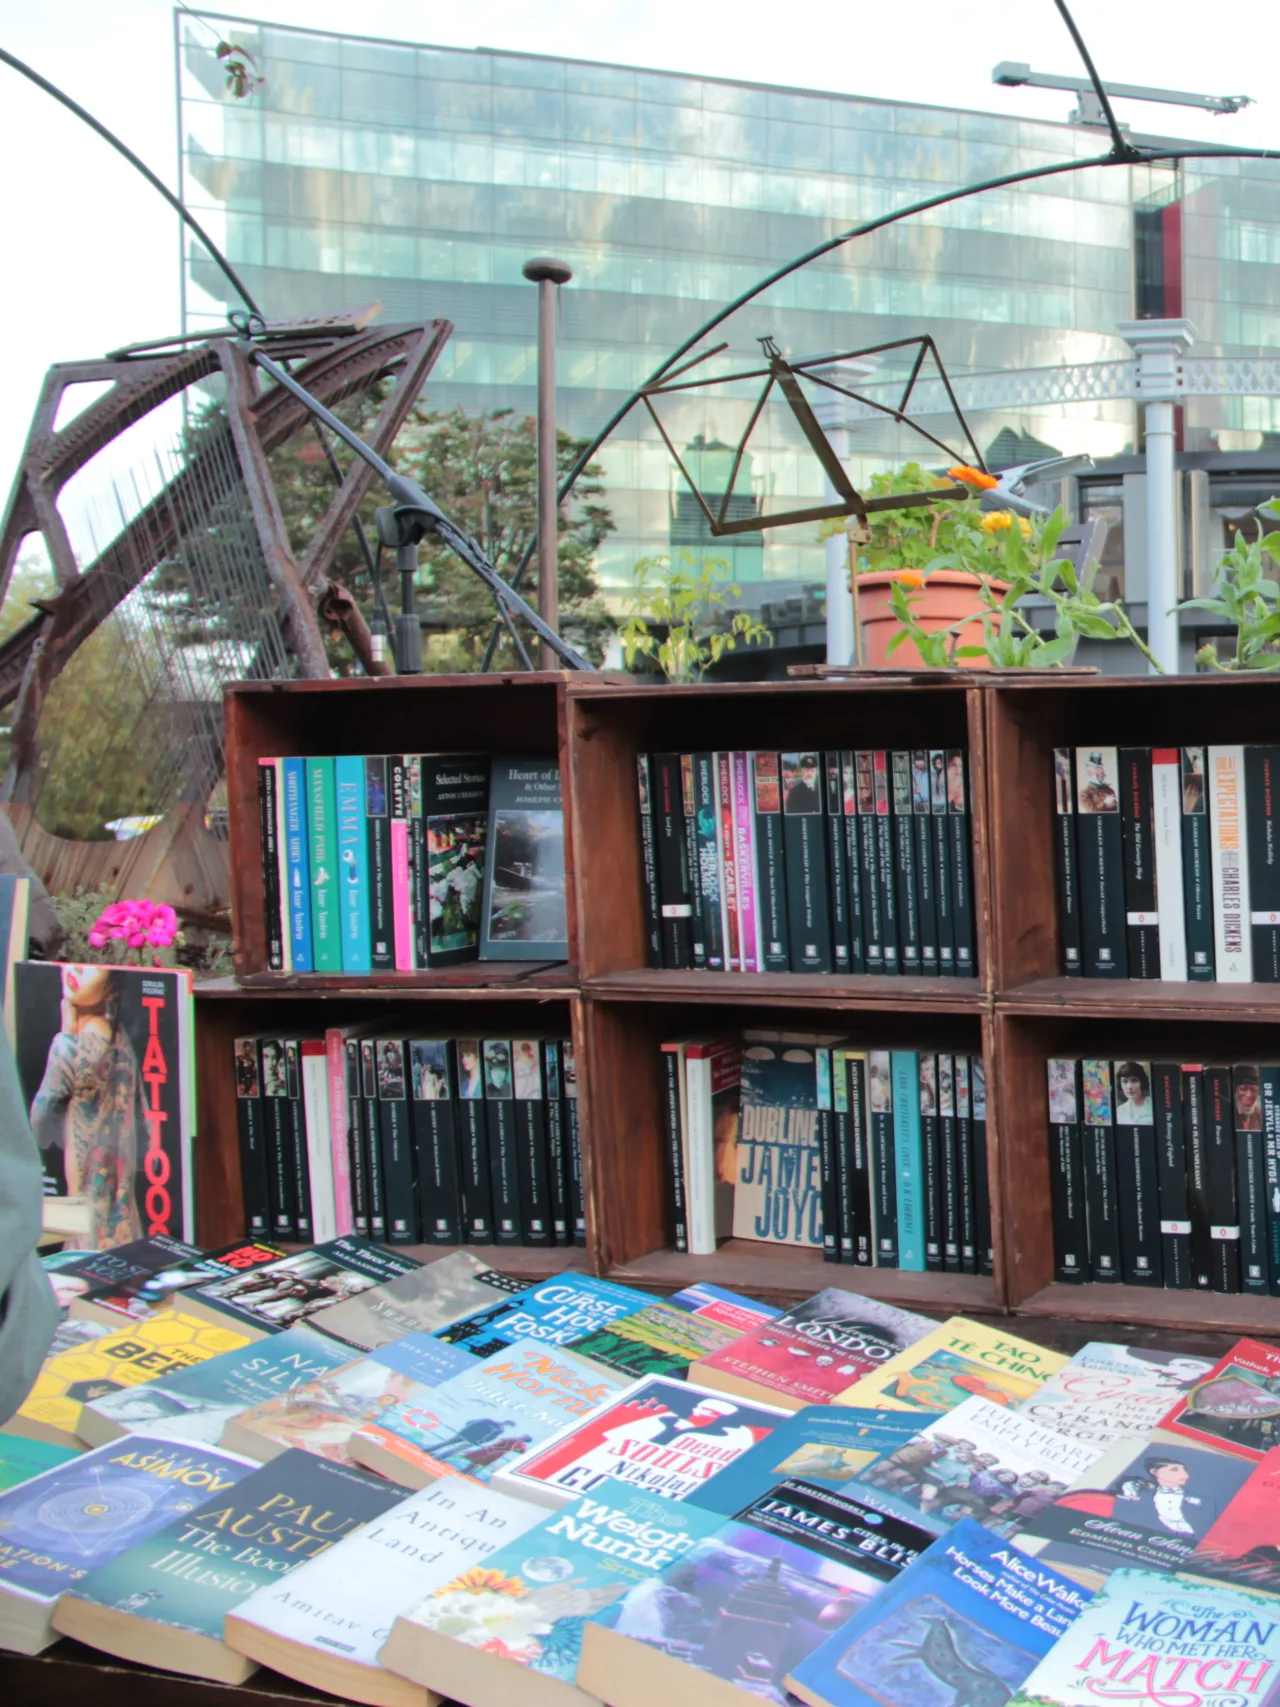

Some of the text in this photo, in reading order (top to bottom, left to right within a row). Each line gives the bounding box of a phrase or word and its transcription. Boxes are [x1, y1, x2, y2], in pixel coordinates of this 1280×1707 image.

[394, 766, 404, 816] COLETTE
[435, 772, 485, 786] Selected Stories
[508, 768, 552, 781] Heart of
[533, 783, 556, 792] Other
[701, 759, 710, 806] SHERLOCK
[719, 759, 729, 805] SHERLOCK
[735, 758, 745, 804] SHERLOCK
[341, 782, 360, 940] EMMA Jane Austen
[699, 847, 711, 896] HOLMES
[705, 840, 719, 903] SHERLOCK
[737, 827, 750, 911] BASKERVILLES
[1215, 770, 1243, 953] EXPECTATIONS CHARLES DICKENS
[317, 888, 328, 908] Jane
[724, 860, 736, 912] SCARLET
[295, 911, 305, 940] Austen
[318, 911, 329, 940] Austen
[1189, 1076, 1202, 1190] BERNARD SHAW PLAYS UNPLEASANT
[1263, 1082, 1278, 1184] DR JEKYLL MR HYDE
[740, 1146, 820, 1187] JAME
[754, 1184, 824, 1244] JOYC
[334, 1238, 387, 1266] The Three
[533, 1285, 629, 1317] CURSE
[170, 1348, 206, 1364] THE
[720, 1354, 788, 1384] STEPHEN
[992, 1340, 1042, 1364] TAO
[1231, 1355, 1270, 1375] Vathek
[522, 1351, 610, 1405] Nick
[1027, 1402, 1154, 1432] CYRANO
[607, 1437, 722, 1480] SOULS
[673, 1436, 743, 1463] Dead
[1028, 1429, 1095, 1463] HEART
[107, 1452, 237, 1493] ASIMOV
[425, 1489, 508, 1530] In An
[760, 1499, 854, 1541] JAMES
[797, 1483, 867, 1517] MASTERWORKS
[176, 1522, 231, 1557] The
[366, 1526, 444, 1565] Land
[395, 1509, 497, 1554] Antiqu
[574, 1498, 697, 1553] Weigh
[1068, 1527, 1134, 1550] EDMUND
[1083, 1518, 1195, 1558] Swan Song
[945, 1545, 995, 1585] Horses
[995, 1576, 1035, 1607] Make
[989, 1548, 1037, 1584] Alice
[271, 1588, 362, 1633] Amitav
[952, 1566, 1030, 1622] Look More
[1121, 1600, 1278, 1647] WOMAN
[1115, 1627, 1261, 1664] WHO MET HER
[1074, 1637, 1274, 1700] MATCH
